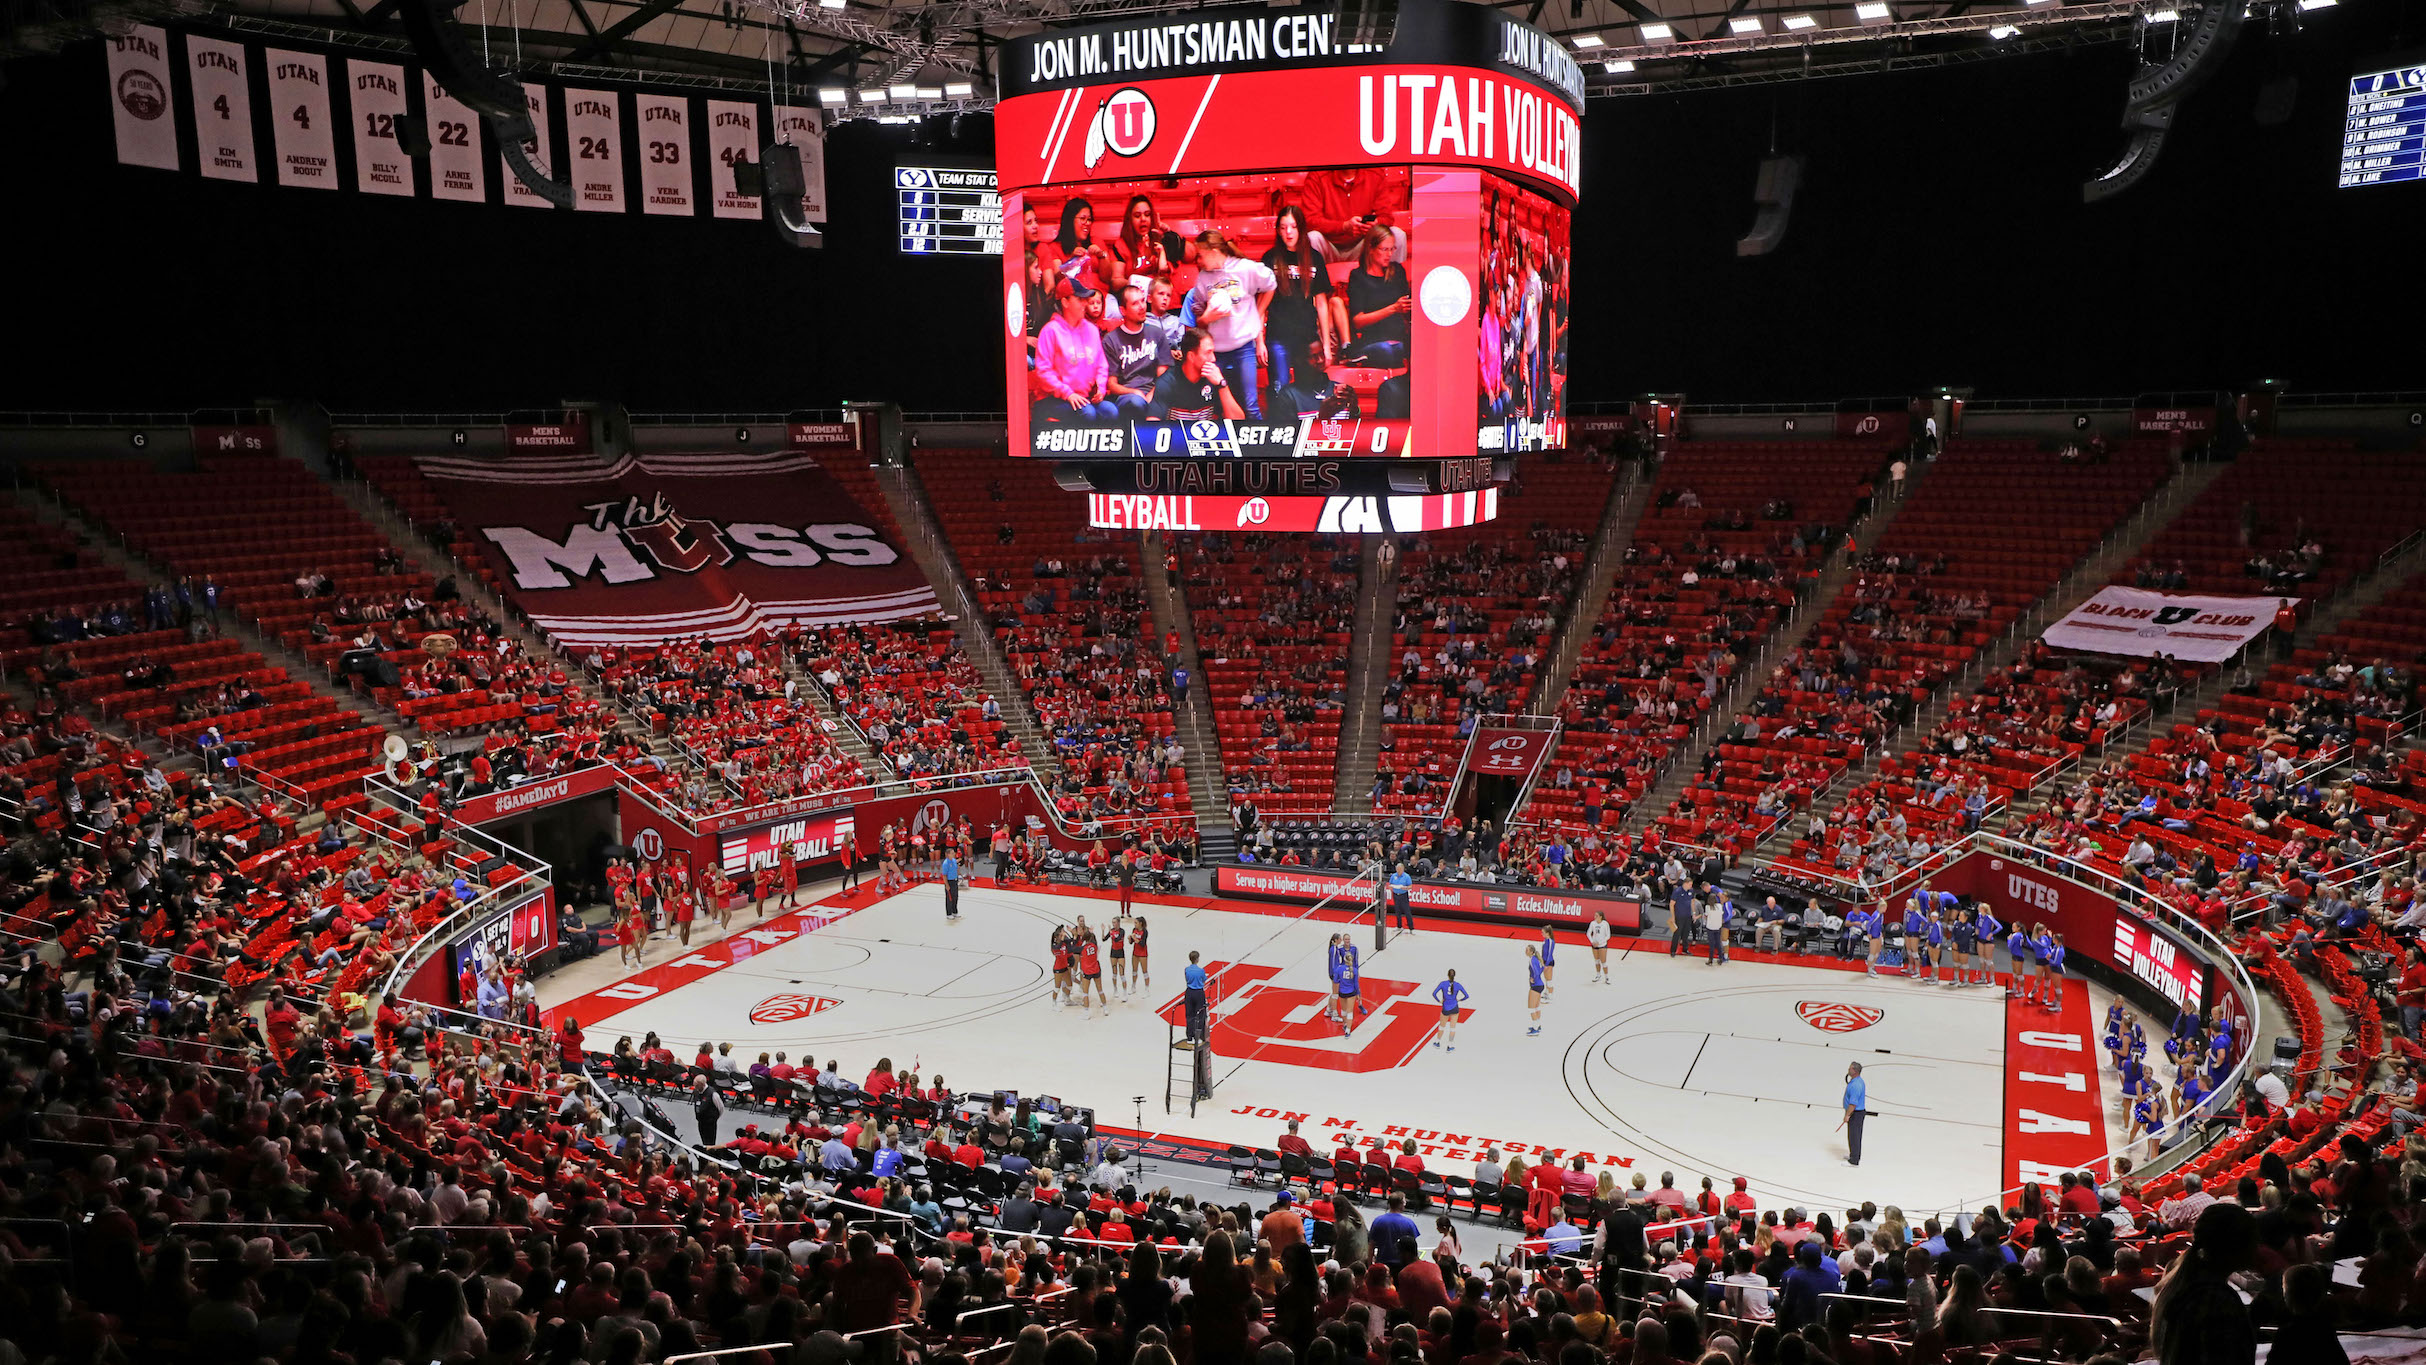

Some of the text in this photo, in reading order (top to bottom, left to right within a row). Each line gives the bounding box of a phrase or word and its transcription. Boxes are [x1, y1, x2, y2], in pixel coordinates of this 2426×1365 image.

[115, 35, 160, 61] UTAH
[1032, 13, 1383, 82] JON M. HUNTSMAN CEN
[1505, 21, 1541, 73] JON M.
[198, 51, 239, 75] UTAH
[276, 64, 320, 86] UTAH
[2371, 75, 2384, 92] 0
[358, 74, 398, 96] UTAH
[213, 94, 230, 120] 4
[574, 101, 611, 120] UTAH
[645, 106, 681, 125] UTAH
[293, 104, 310, 130] 4
[366, 112, 394, 139] 12
[716, 112, 751, 130] UTAH
[782, 117, 816, 134] UTAH
[1358, 75, 1494, 160] UTAH
[2349, 120, 2355, 130] 7
[2368, 113, 2397, 127] BOWER
[438, 121, 469, 147] 22
[2367, 126, 2408, 141] ROBINSON
[218, 147, 236, 157] KIM
[579, 137, 609, 160] 24
[650, 142, 680, 164] 33
[2363, 141, 2401, 155] GRIMMER
[214, 158, 243, 169] SMITH
[286, 155, 327, 167] ANDREW
[372, 163, 398, 174] BILLY
[2363, 156, 2392, 169] MILLER
[293, 166, 323, 177] BOGUT
[445, 170, 471, 180] ARNIE
[938, 173, 988, 186] TEAM STAT
[2362, 172, 2382, 183] LAKE
[444, 180, 473, 191] FERRIN
[584, 183, 612, 192] ANDRE
[657, 187, 679, 196] VERN
[584, 192, 614, 202] MILLER
[650, 196, 687, 206] GARDNER
[718, 200, 758, 210] VAN HORN
[915, 207, 922, 220] 1
[908, 223, 929, 236] 2.0
[912, 238, 926, 251] 12
[1120, 338, 1157, 369] Hurley
[2078, 417, 2087, 428] P
[2156, 411, 2187, 421] MEN'S
[2411, 413, 2423, 425] Q
[532, 427, 560, 437] MEN'S
[802, 425, 844, 435] WOMEN'S
[1785, 420, 1794, 430] N
[134, 434, 145, 447] G
[455, 433, 464, 444] H
[516, 435, 575, 446] BASKETBALL
[740, 431, 747, 441] J
[795, 433, 850, 444] BASKETBALL
[1036, 428, 1124, 452] #GOUTES
[1155, 427, 1172, 453] 0
[1238, 426, 1269, 445] SET
[1270, 426, 1295, 445] #2
[1371, 426, 1389, 453] 0
[1135, 461, 1341, 494] UTAH UTES
[1440, 457, 1493, 491] UTAH UTES
[583, 491, 676, 530] The
[482, 513, 899, 590] MUSS
[2081, 603, 2255, 626] BLOCK U CLUB
[744, 811, 760, 822] WE
[762, 807, 779, 818] ARE
[781, 803, 798, 814] THE
[799, 799, 824, 810] MUSS
[770, 821, 806, 846] UTAH
[1236, 873, 1255, 888] Serve
[1256, 878, 1267, 890] up
[1268, 879, 1273, 889] a
[1274, 877, 1298, 894] higher
[1298, 881, 1322, 898] salary
[1322, 883, 1339, 895] with
[1345, 885, 1373, 901] degree
[1408, 889, 1431, 904] Eccles
[1432, 890, 1461, 906] School!
[1517, 897, 1582, 916] Eccles.Utah.edu
[2008, 873, 2059, 914] UTES
[487, 922, 499, 942] SET
[499, 917, 509, 934] #2
[531, 915, 539, 938] 0
[1086, 946, 1095, 956] 12
[2150, 933, 2175, 970] UTAH
[2132, 951, 2186, 1008] VOLLEYBALL
[2018, 1030, 2096, 1187] UTAH
[1230, 1105, 1636, 1168] JON M. HUNTSMAN
